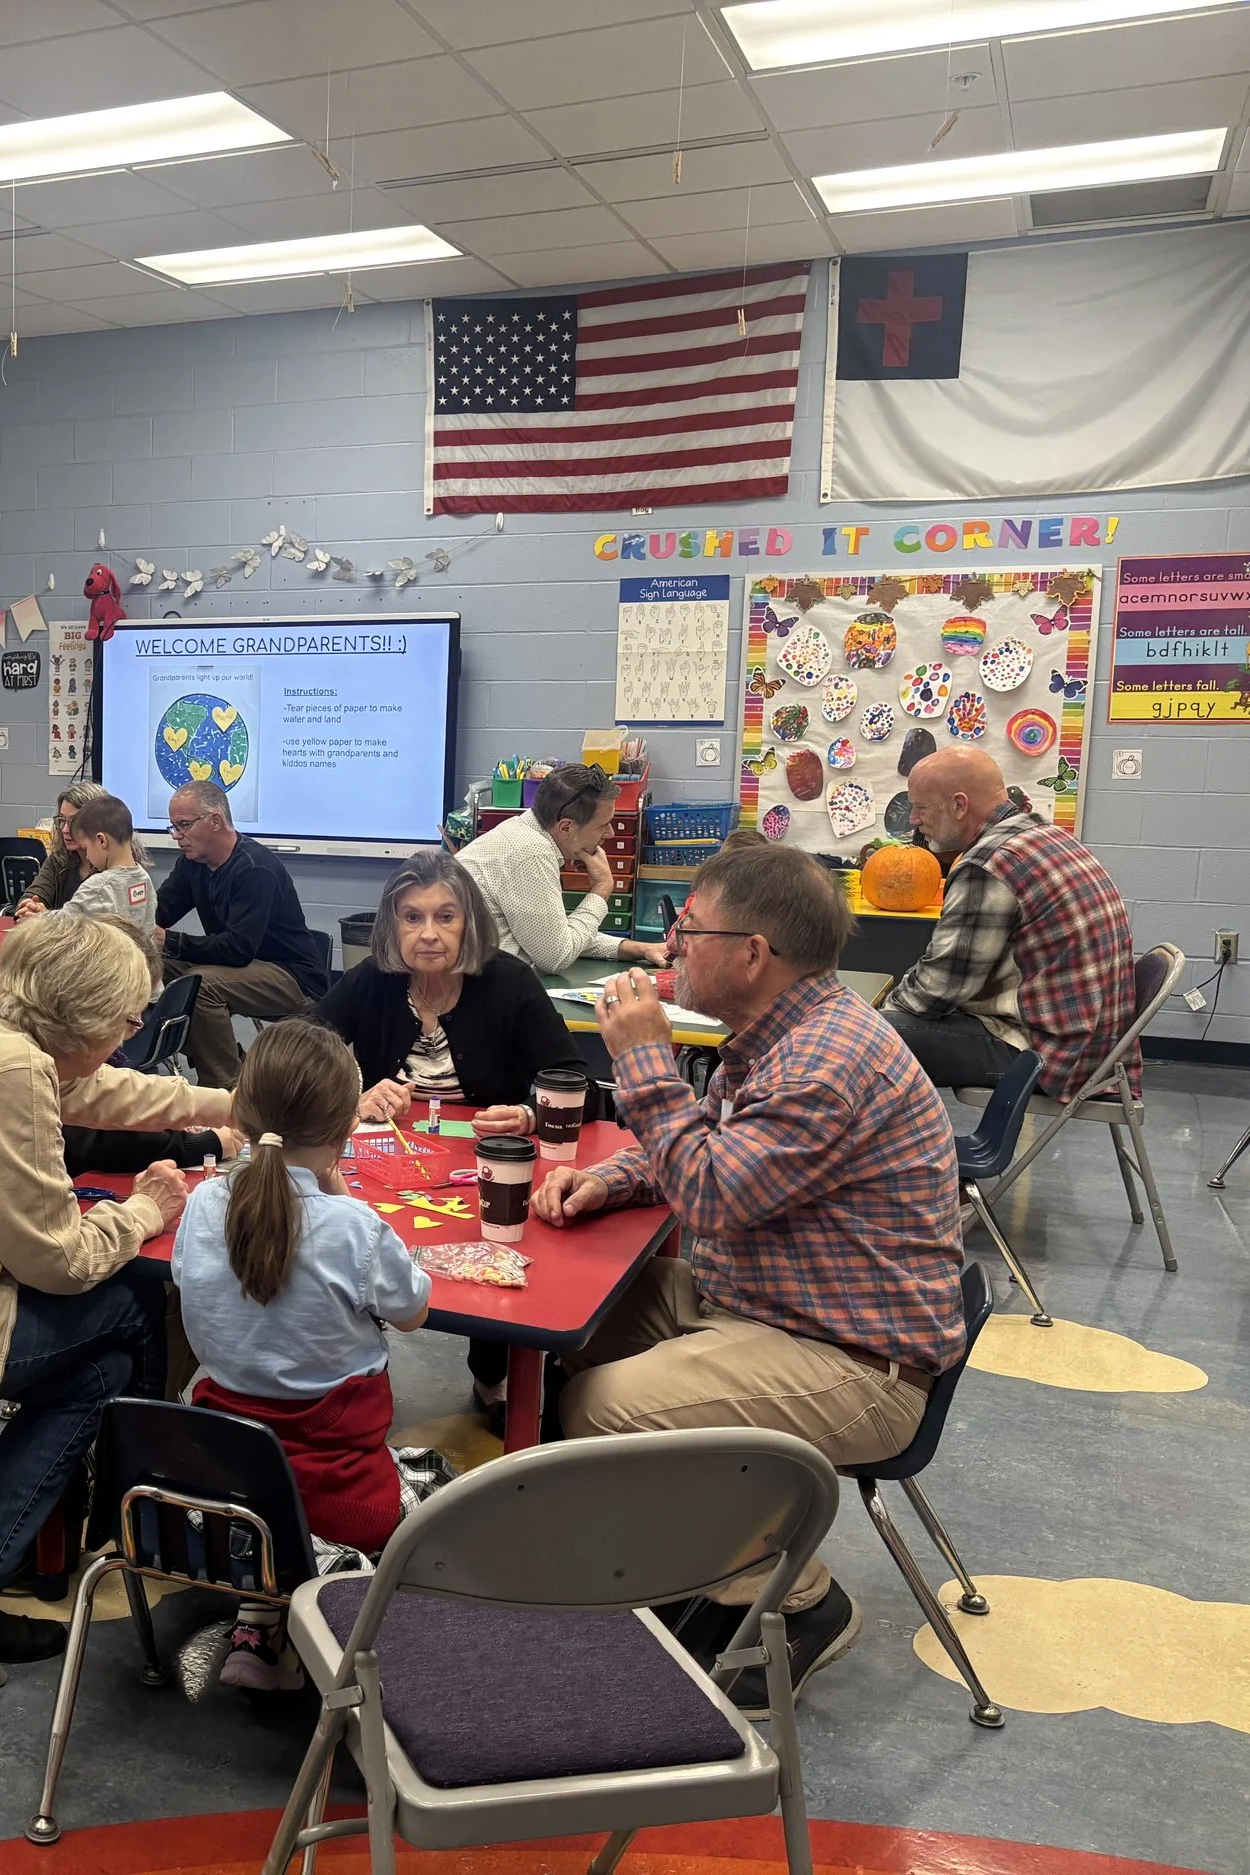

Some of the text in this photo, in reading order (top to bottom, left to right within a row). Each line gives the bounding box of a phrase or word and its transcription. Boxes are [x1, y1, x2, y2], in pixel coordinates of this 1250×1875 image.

[593, 517, 1120, 560] CRUSHED IT CORNER!
[650, 578, 698, 588] American
[1123, 573, 1156, 584] Some
[1160, 570, 1200, 582] letters
[1203, 572, 1224, 581] are
[640, 589, 708, 600] Sign Language
[1119, 627, 1151, 638] Some
[1155, 625, 1195, 637] letters
[1224, 625, 1247, 635] tall.
[59, 641, 87, 651] Feelings
[136, 638, 226, 654] WELCOME
[232, 635, 392, 653] GRANDPARENTS!!
[1147, 640, 1228, 658] bdfhiklt
[3, 660, 37, 676] hard
[5, 675, 37, 687] AT FIRST
[152, 673, 195, 682] Grandparents
[197, 673, 210, 682] light
[284, 688, 338, 696] Instructions:
[1116, 680, 1219, 692] Some letters fall.
[306, 704, 332, 714] pieces
[334, 704, 342, 712] of
[344, 705, 367, 714] paper
[1152, 698, 1216, 719] gjpqy
[302, 738, 327, 747] yellow
[327, 750, 380, 758] grandparents
